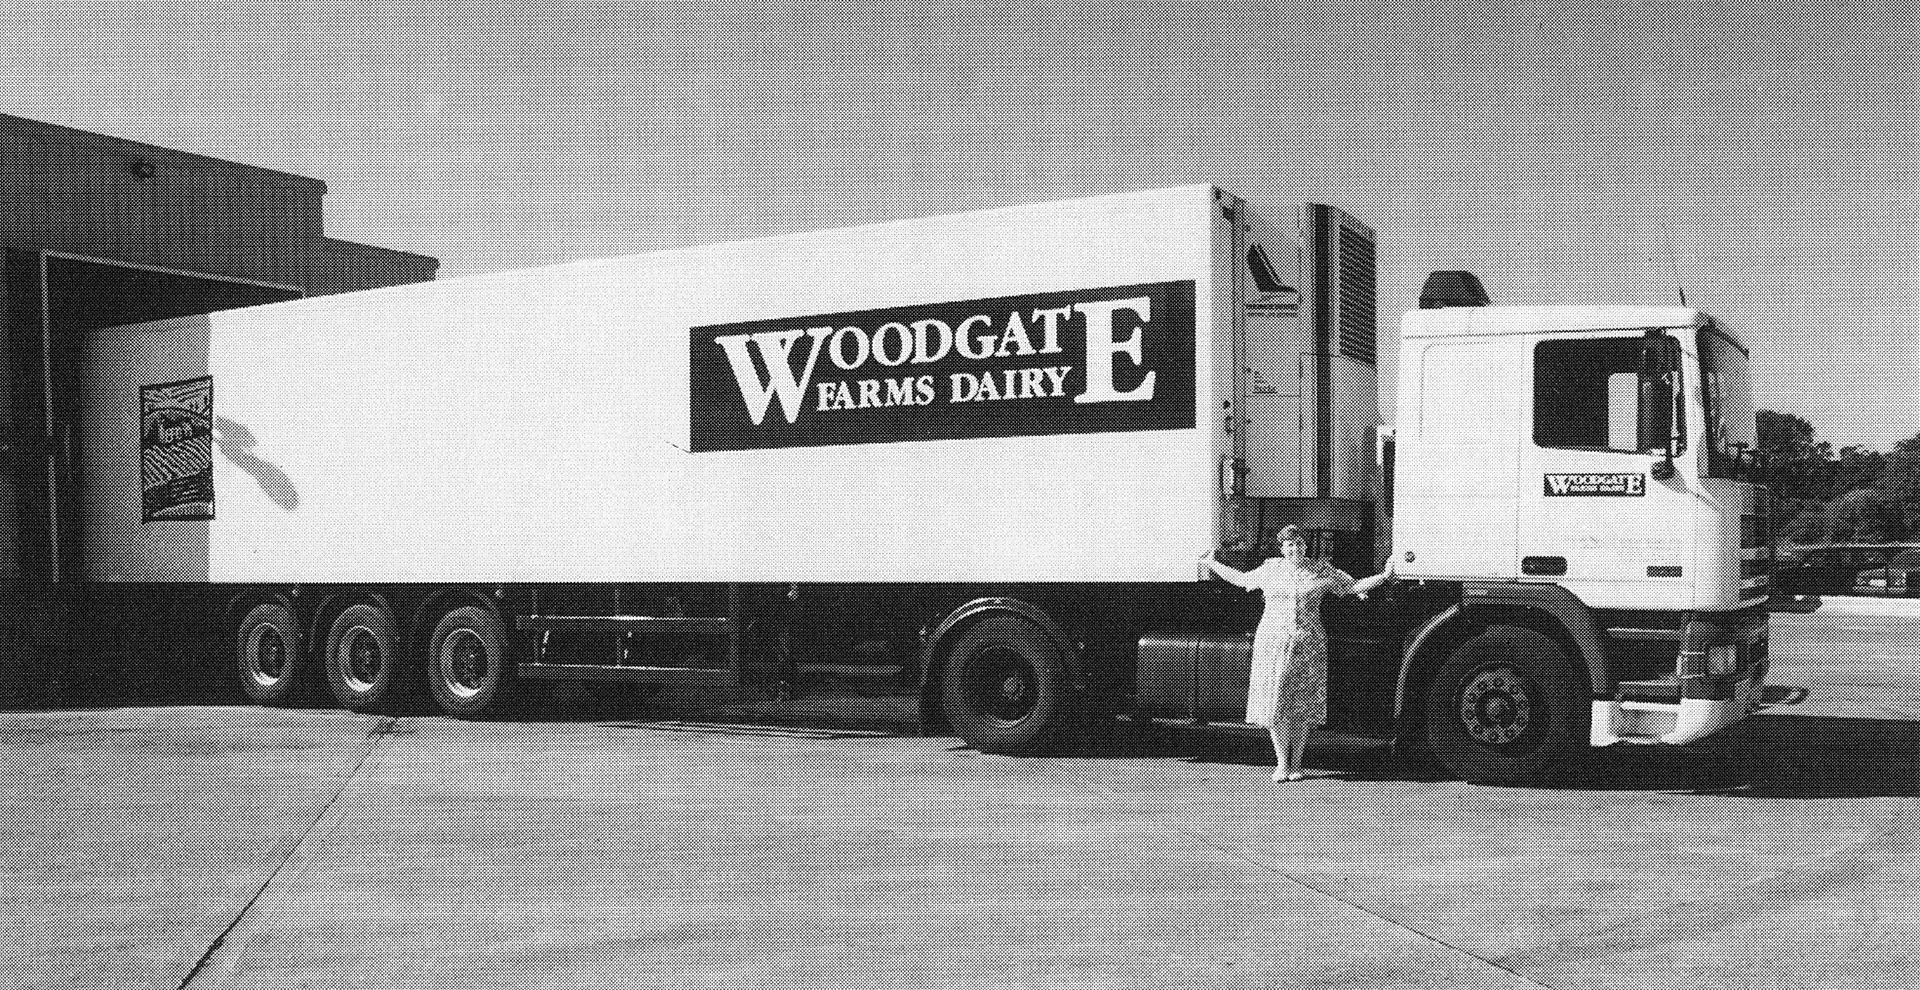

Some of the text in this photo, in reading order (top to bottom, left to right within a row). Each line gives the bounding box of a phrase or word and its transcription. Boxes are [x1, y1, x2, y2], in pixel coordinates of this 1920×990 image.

[715, 296, 1156, 425] WOODGATE
[816, 366, 1072, 411] FARMS DAIRY
